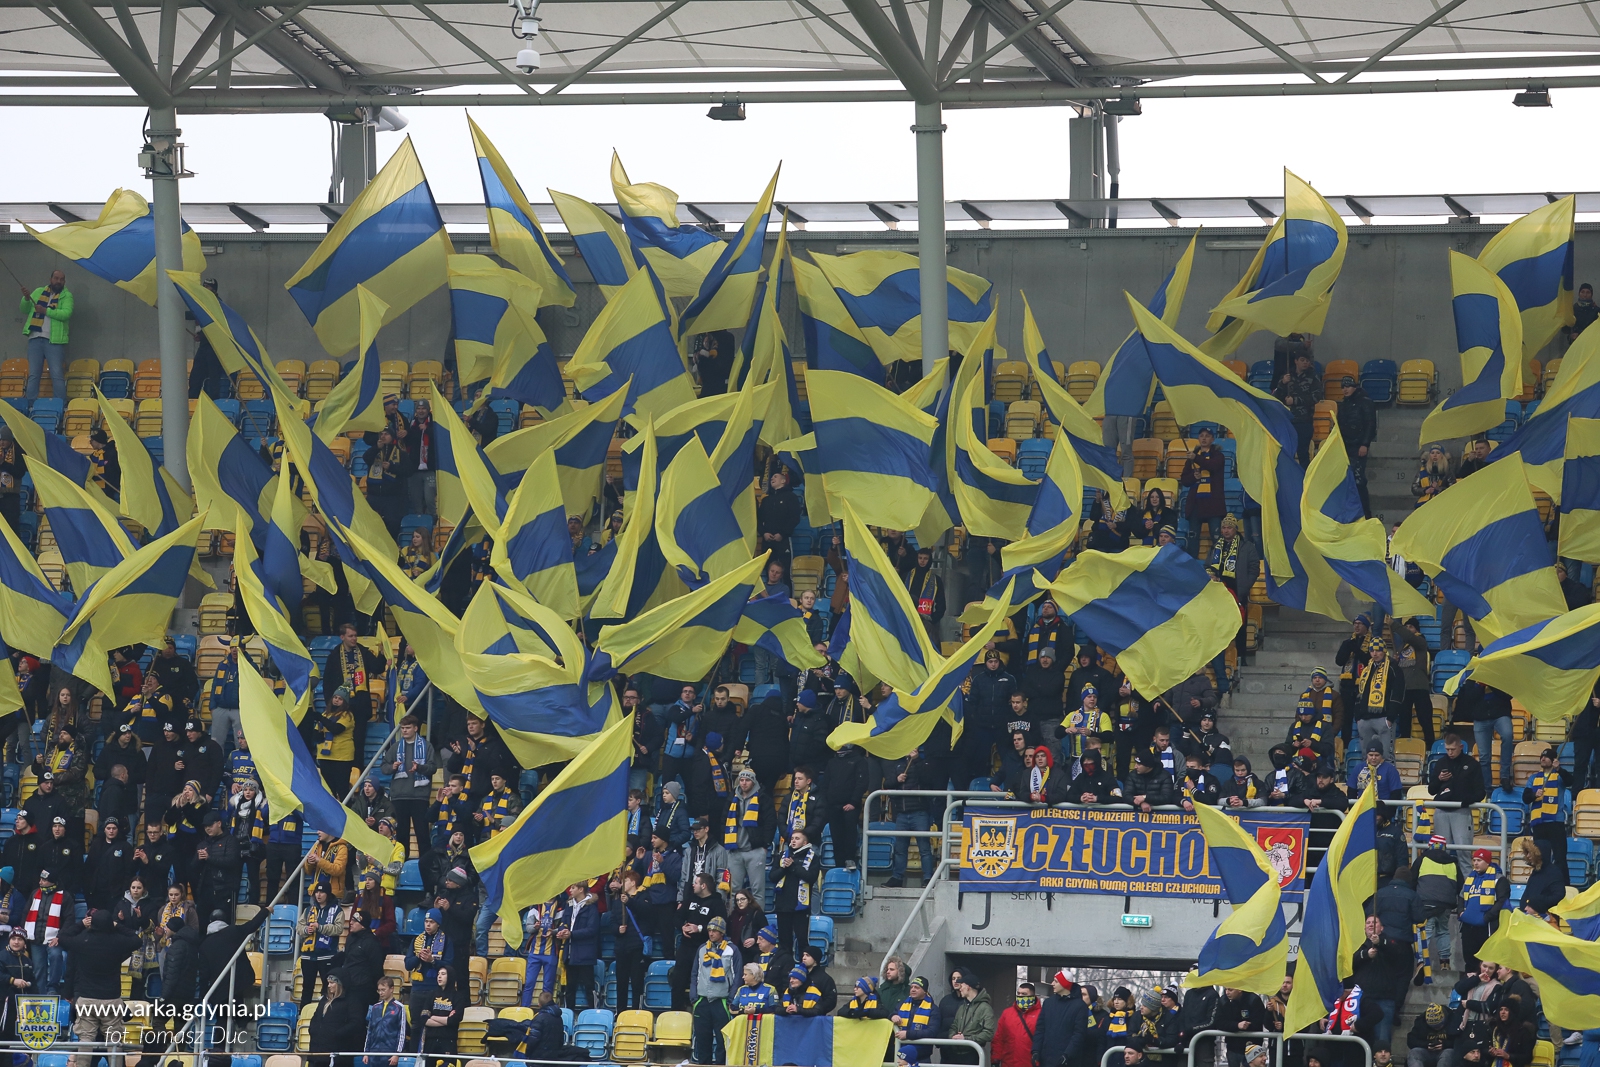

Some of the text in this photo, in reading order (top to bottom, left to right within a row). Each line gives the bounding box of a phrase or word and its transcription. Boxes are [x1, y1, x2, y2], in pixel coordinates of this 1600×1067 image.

[1396, 472, 1406, 480] 19
[1307, 642, 1317, 650] 15
[1283, 684, 1293, 692] 14
[1260, 727, 1270, 735] 13
[1138, 812, 1149, 823] TO
[1151, 811, 1181, 825] ŻADNA
[1022, 824, 1222, 878] CZŁUCHÓ
[1040, 876, 1221, 895] ARKA GDYNIA DUMĄ CAŁEGO CZŁUCHOWA
[1010, 891, 1056, 901] SEKTOR
[963, 936, 1031, 948] MIEJSCA 40-21
[747, 1027, 758, 1061] ARKA
